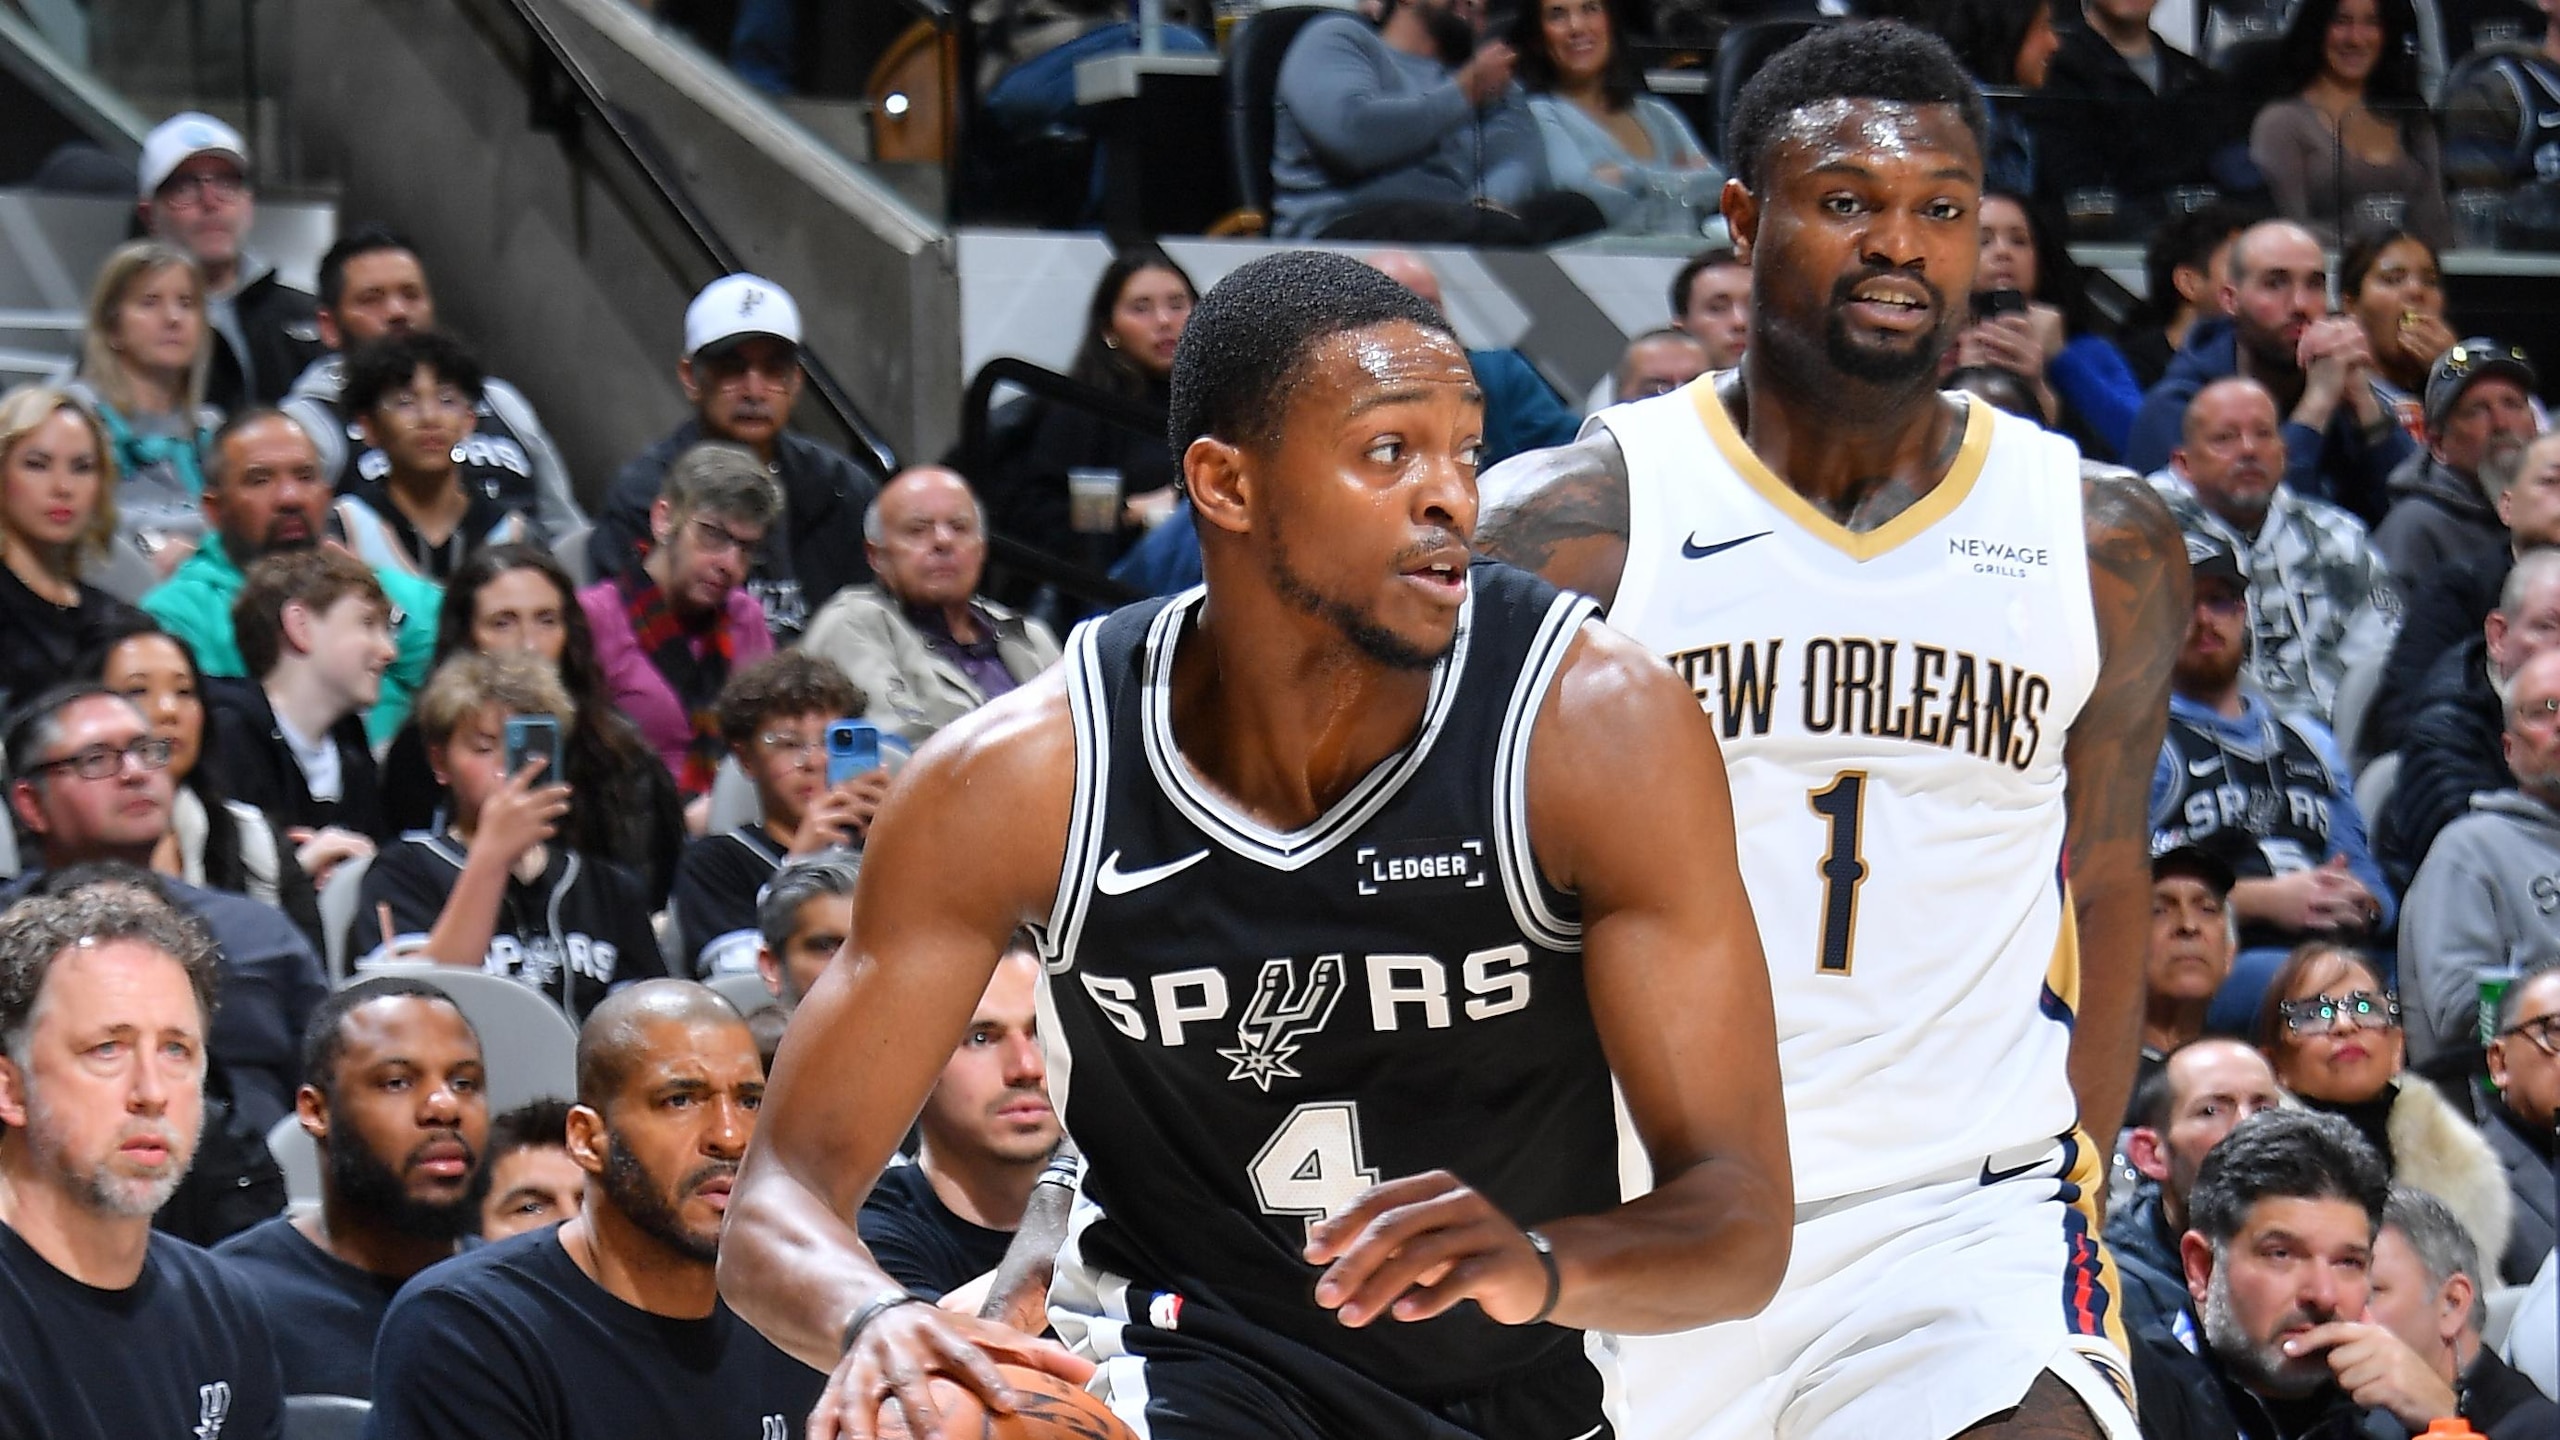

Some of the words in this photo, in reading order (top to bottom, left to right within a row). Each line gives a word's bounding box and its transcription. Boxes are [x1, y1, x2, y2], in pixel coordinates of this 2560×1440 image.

[1948, 537, 2049, 566] NEWAGE
[1973, 562, 2027, 579] GRILLS
[1664, 637, 1785, 739] EW
[1800, 636, 2051, 772] ORLEANS
[1373, 855, 1467, 882] LEDGER
[1807, 768, 1870, 977] 1
[1079, 943, 1532, 1092] SPURS
[1246, 1101, 1380, 1243] 4
